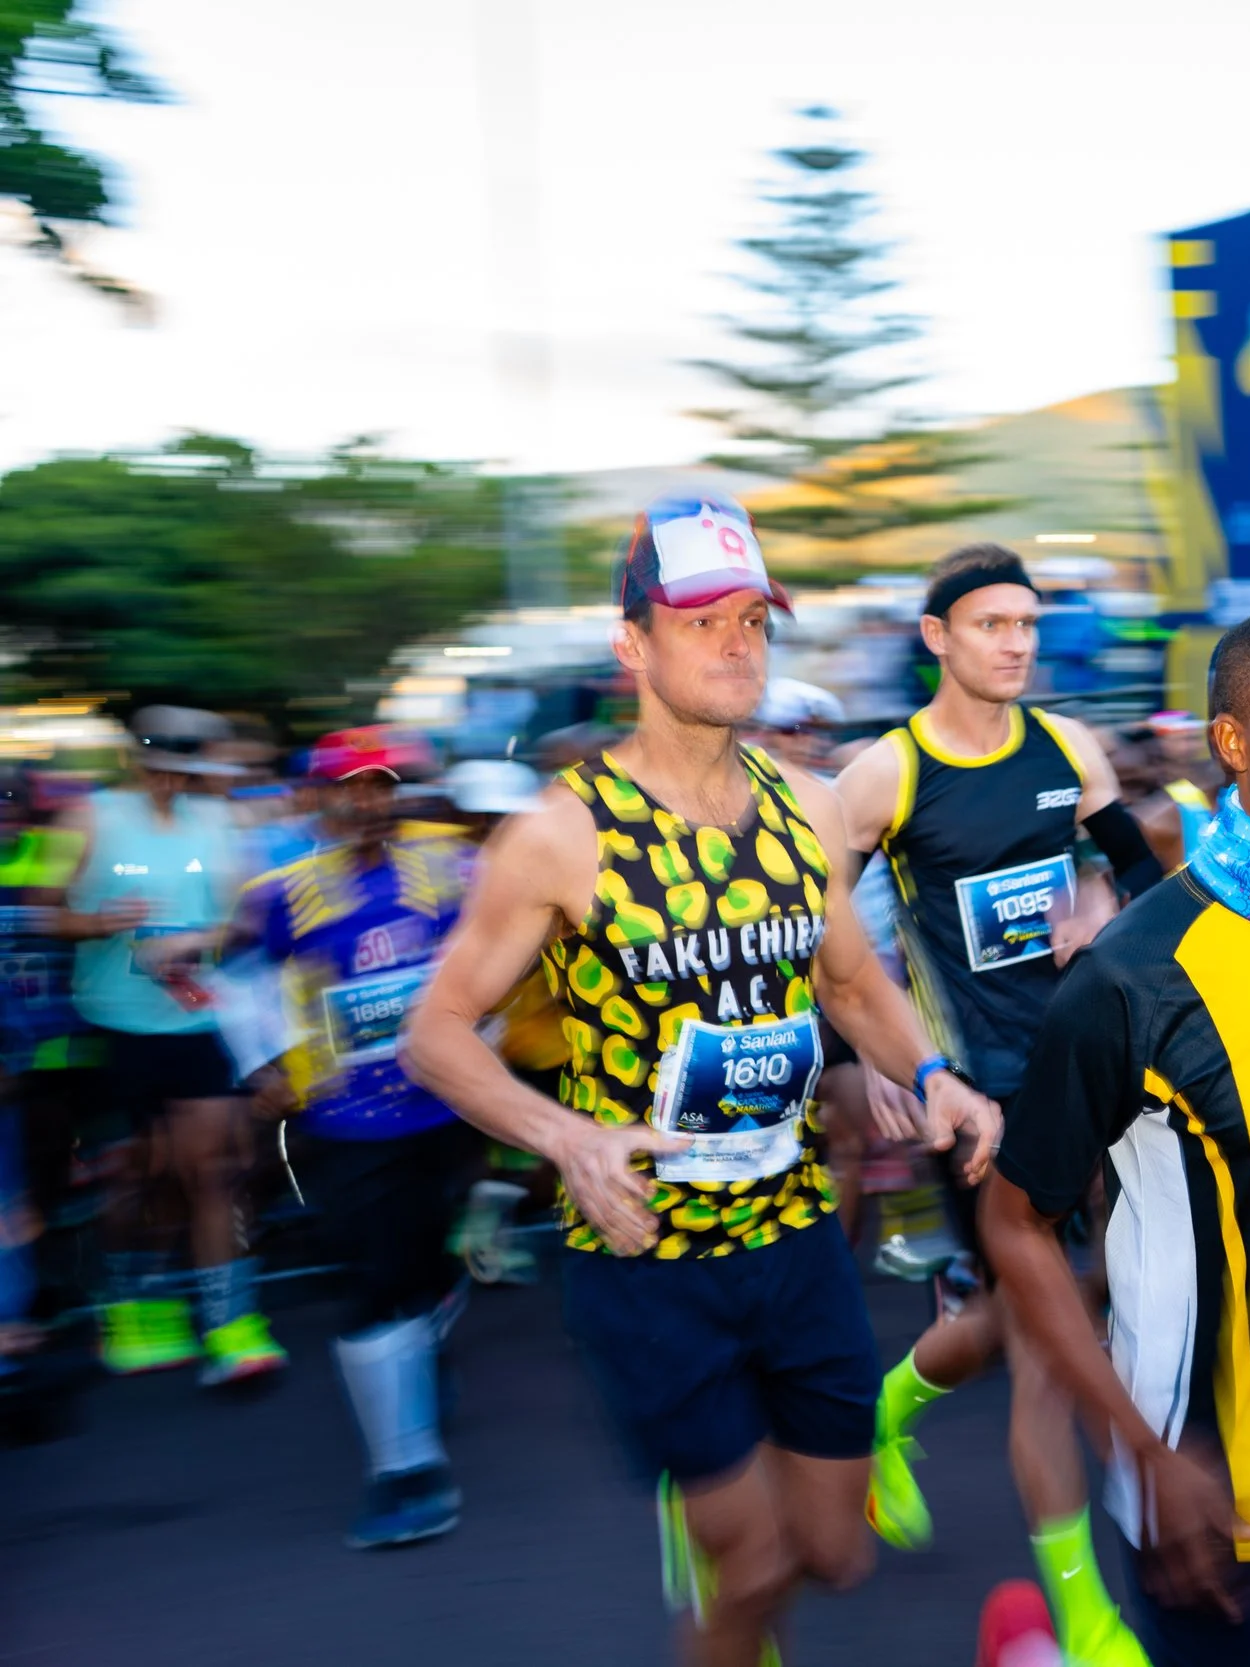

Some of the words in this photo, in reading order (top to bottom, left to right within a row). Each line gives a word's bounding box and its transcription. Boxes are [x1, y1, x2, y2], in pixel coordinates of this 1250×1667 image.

[999, 870, 1055, 892] Sanlam
[992, 886, 1055, 923] 1095
[358, 930, 392, 967] 50
[619, 927, 731, 981] FAKU
[350, 996, 405, 1023] 1685
[739, 1030, 797, 1050] Sanlam
[722, 1054, 790, 1088] 1610
[680, 1112, 704, 1123] ASA
